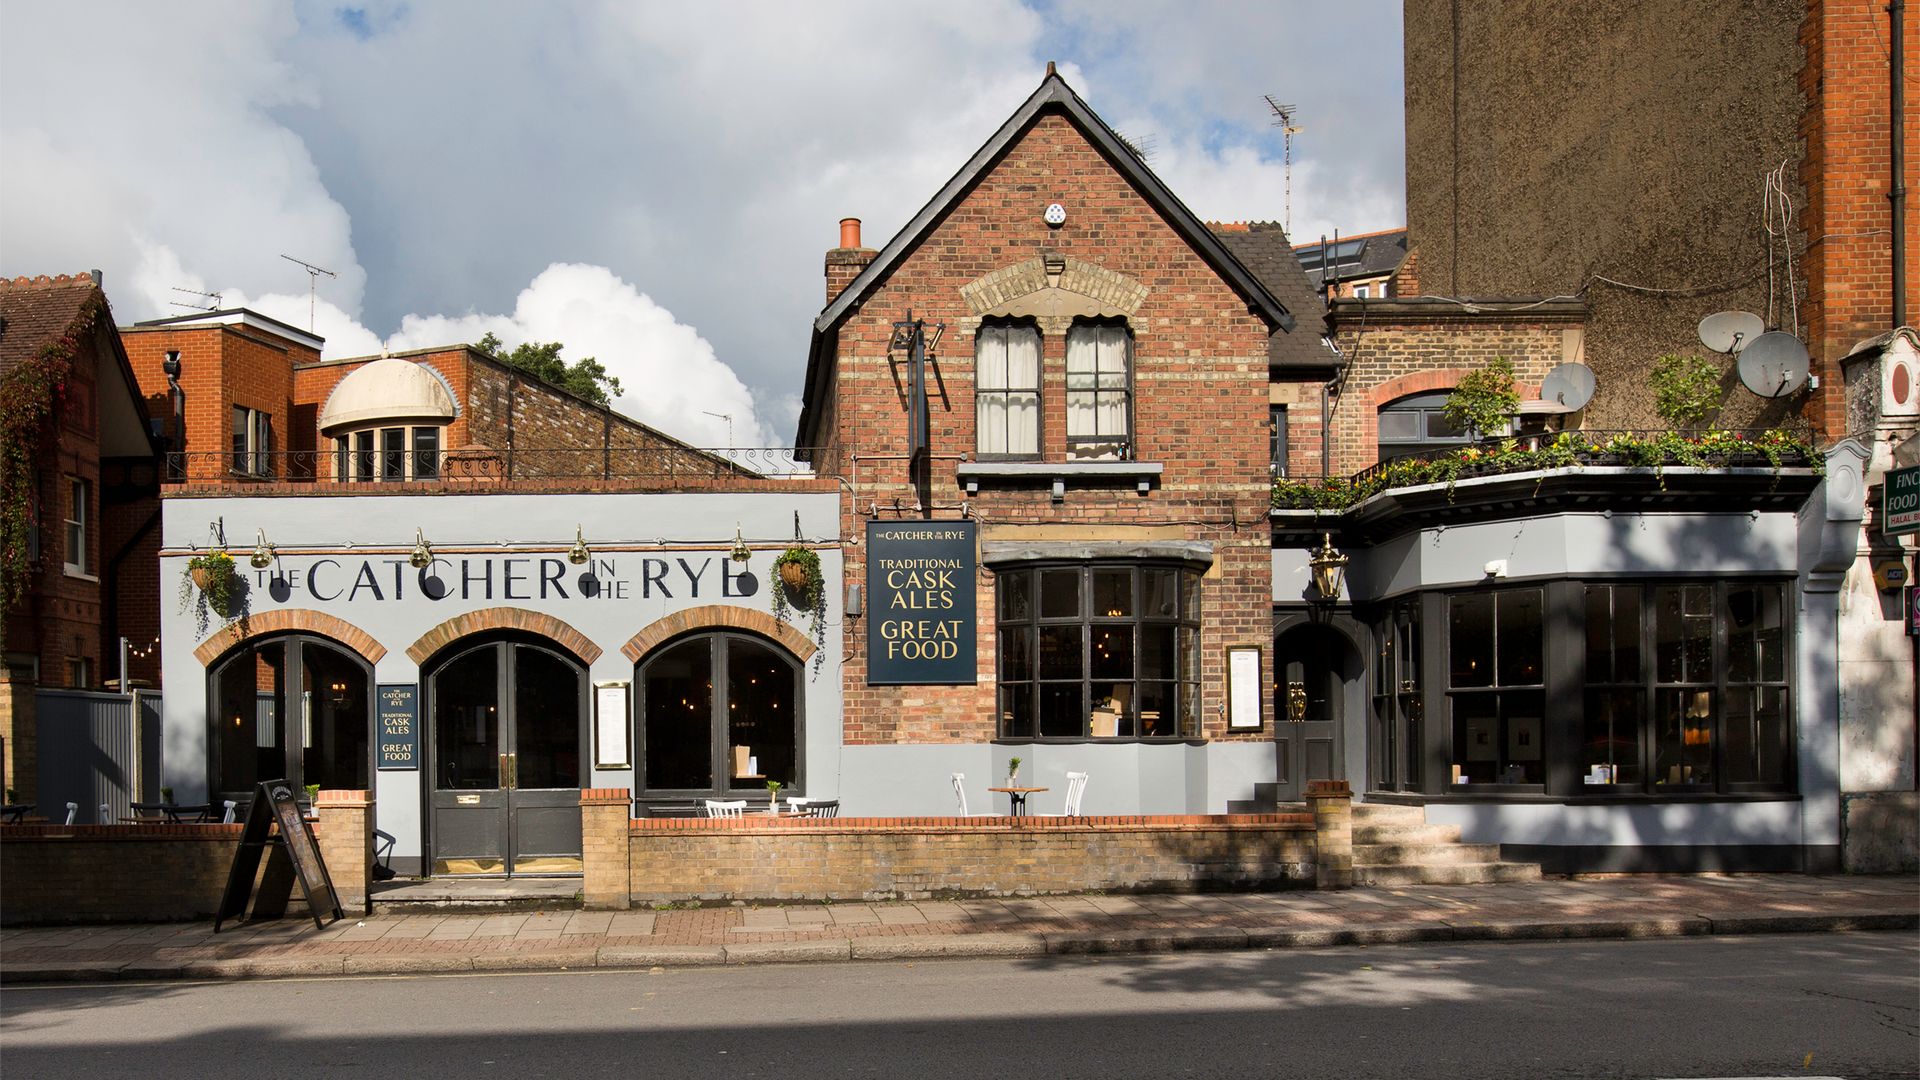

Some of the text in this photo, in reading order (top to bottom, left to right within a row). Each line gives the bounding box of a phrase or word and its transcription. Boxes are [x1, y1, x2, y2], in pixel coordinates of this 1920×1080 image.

[1896, 471, 1920, 489] FINC
[1888, 493, 1917, 511] FOOD
[1890, 514, 1911, 525] HALAL
[885, 531, 933, 540] CATCHER
[945, 531, 966, 540] RYE
[879, 559, 963, 569] TRADITIONAL
[253, 558, 751, 601] THE CATCHER IN THE RYE
[887, 570, 956, 589] CASK
[890, 590, 954, 609] ALES
[880, 620, 963, 639] GREAT
[888, 640, 958, 660] FOOD
[384, 718, 410, 726] CASK
[385, 726, 410, 734] ALES
[382, 744, 412, 752] GREAT
[384, 752, 411, 761] FOOD
